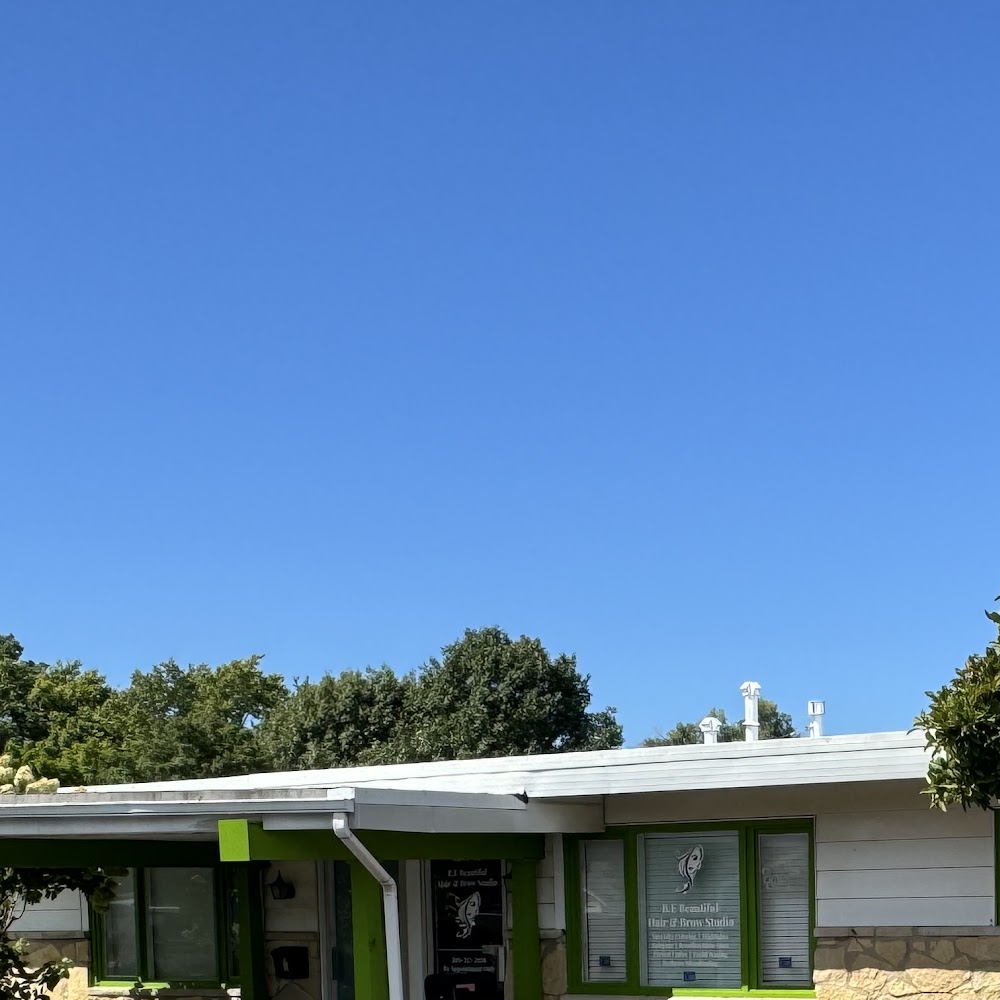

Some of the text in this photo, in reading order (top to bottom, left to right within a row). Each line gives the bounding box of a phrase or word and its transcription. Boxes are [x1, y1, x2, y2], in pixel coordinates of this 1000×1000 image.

[648, 916, 669, 927] Hair
[680, 917, 704, 927] Brow
[705, 916, 734, 927] Studio
